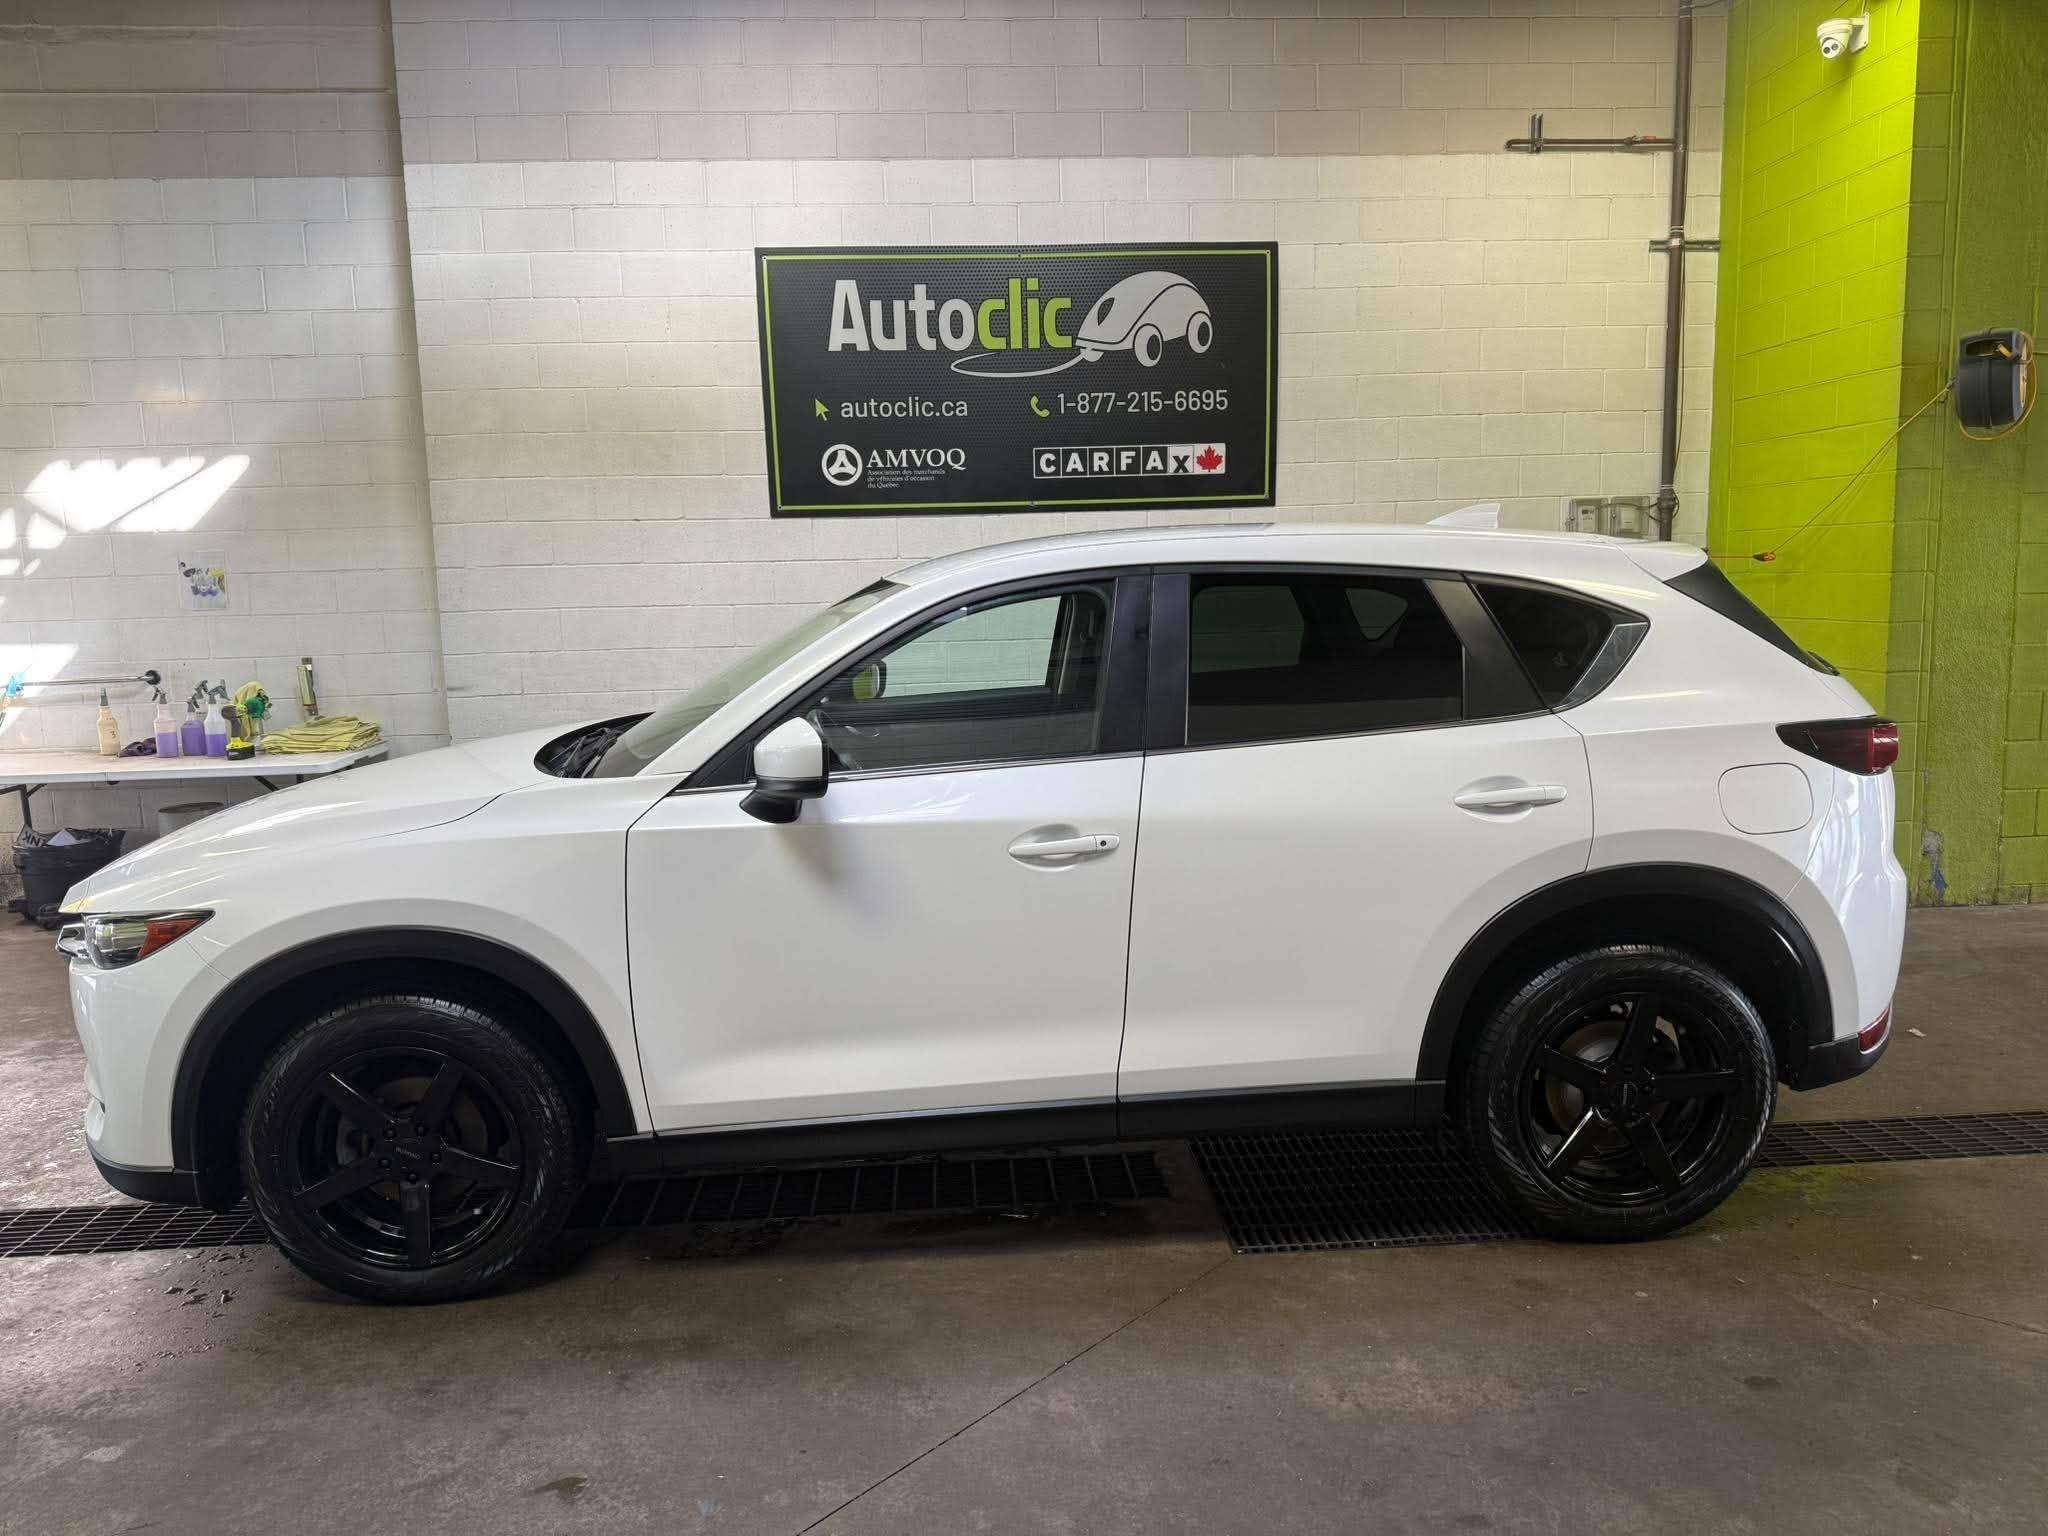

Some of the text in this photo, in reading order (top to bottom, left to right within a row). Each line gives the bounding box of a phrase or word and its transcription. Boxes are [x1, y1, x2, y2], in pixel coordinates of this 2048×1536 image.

[827, 277, 1073, 352] Autoclic
[840, 396, 968, 418] autoclic.ca
[1057, 389, 1229, 414] 1-877-215-6695
[866, 448, 967, 471] AMVOQ
[1038, 449, 1191, 475] CARFAX
